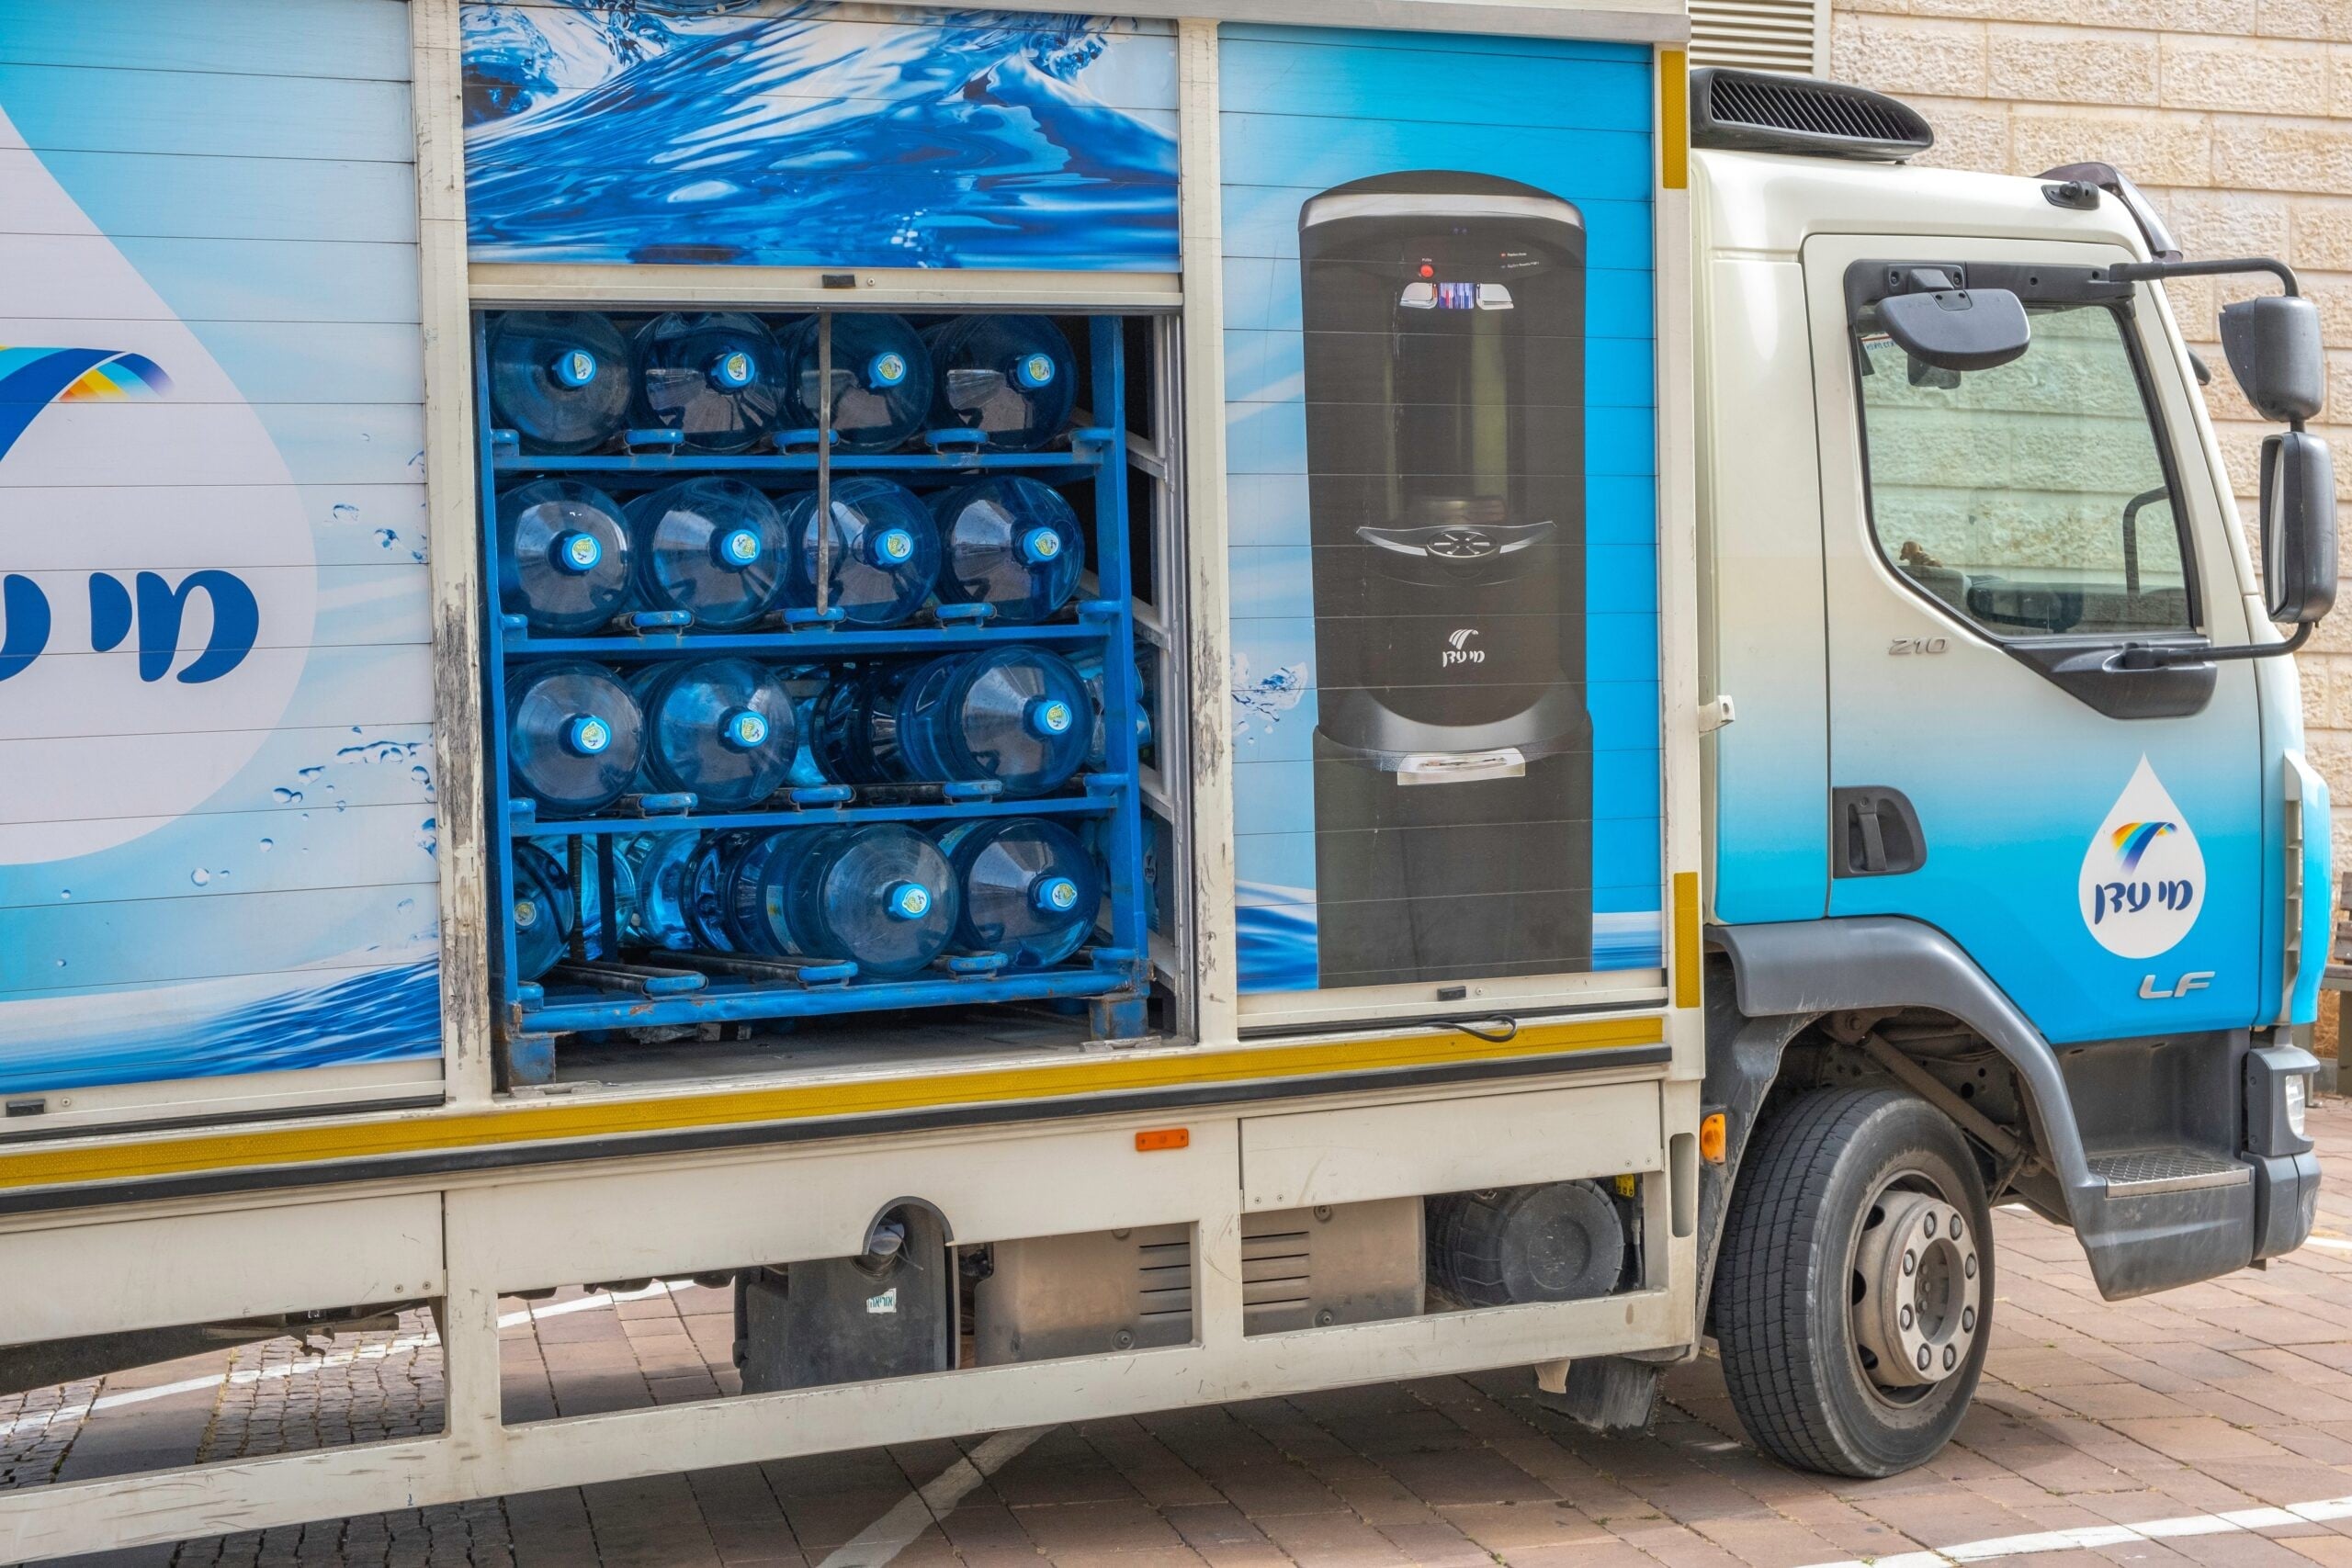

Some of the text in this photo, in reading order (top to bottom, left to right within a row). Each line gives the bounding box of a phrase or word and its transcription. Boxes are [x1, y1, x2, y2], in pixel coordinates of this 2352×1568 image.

[89, 570, 259, 683] מי
[1442, 650, 1486, 668] מי עדן
[1889, 637, 1950, 656] 210
[2094, 879, 2194, 925] מי עדן
[2139, 971, 2216, 1000] LF
